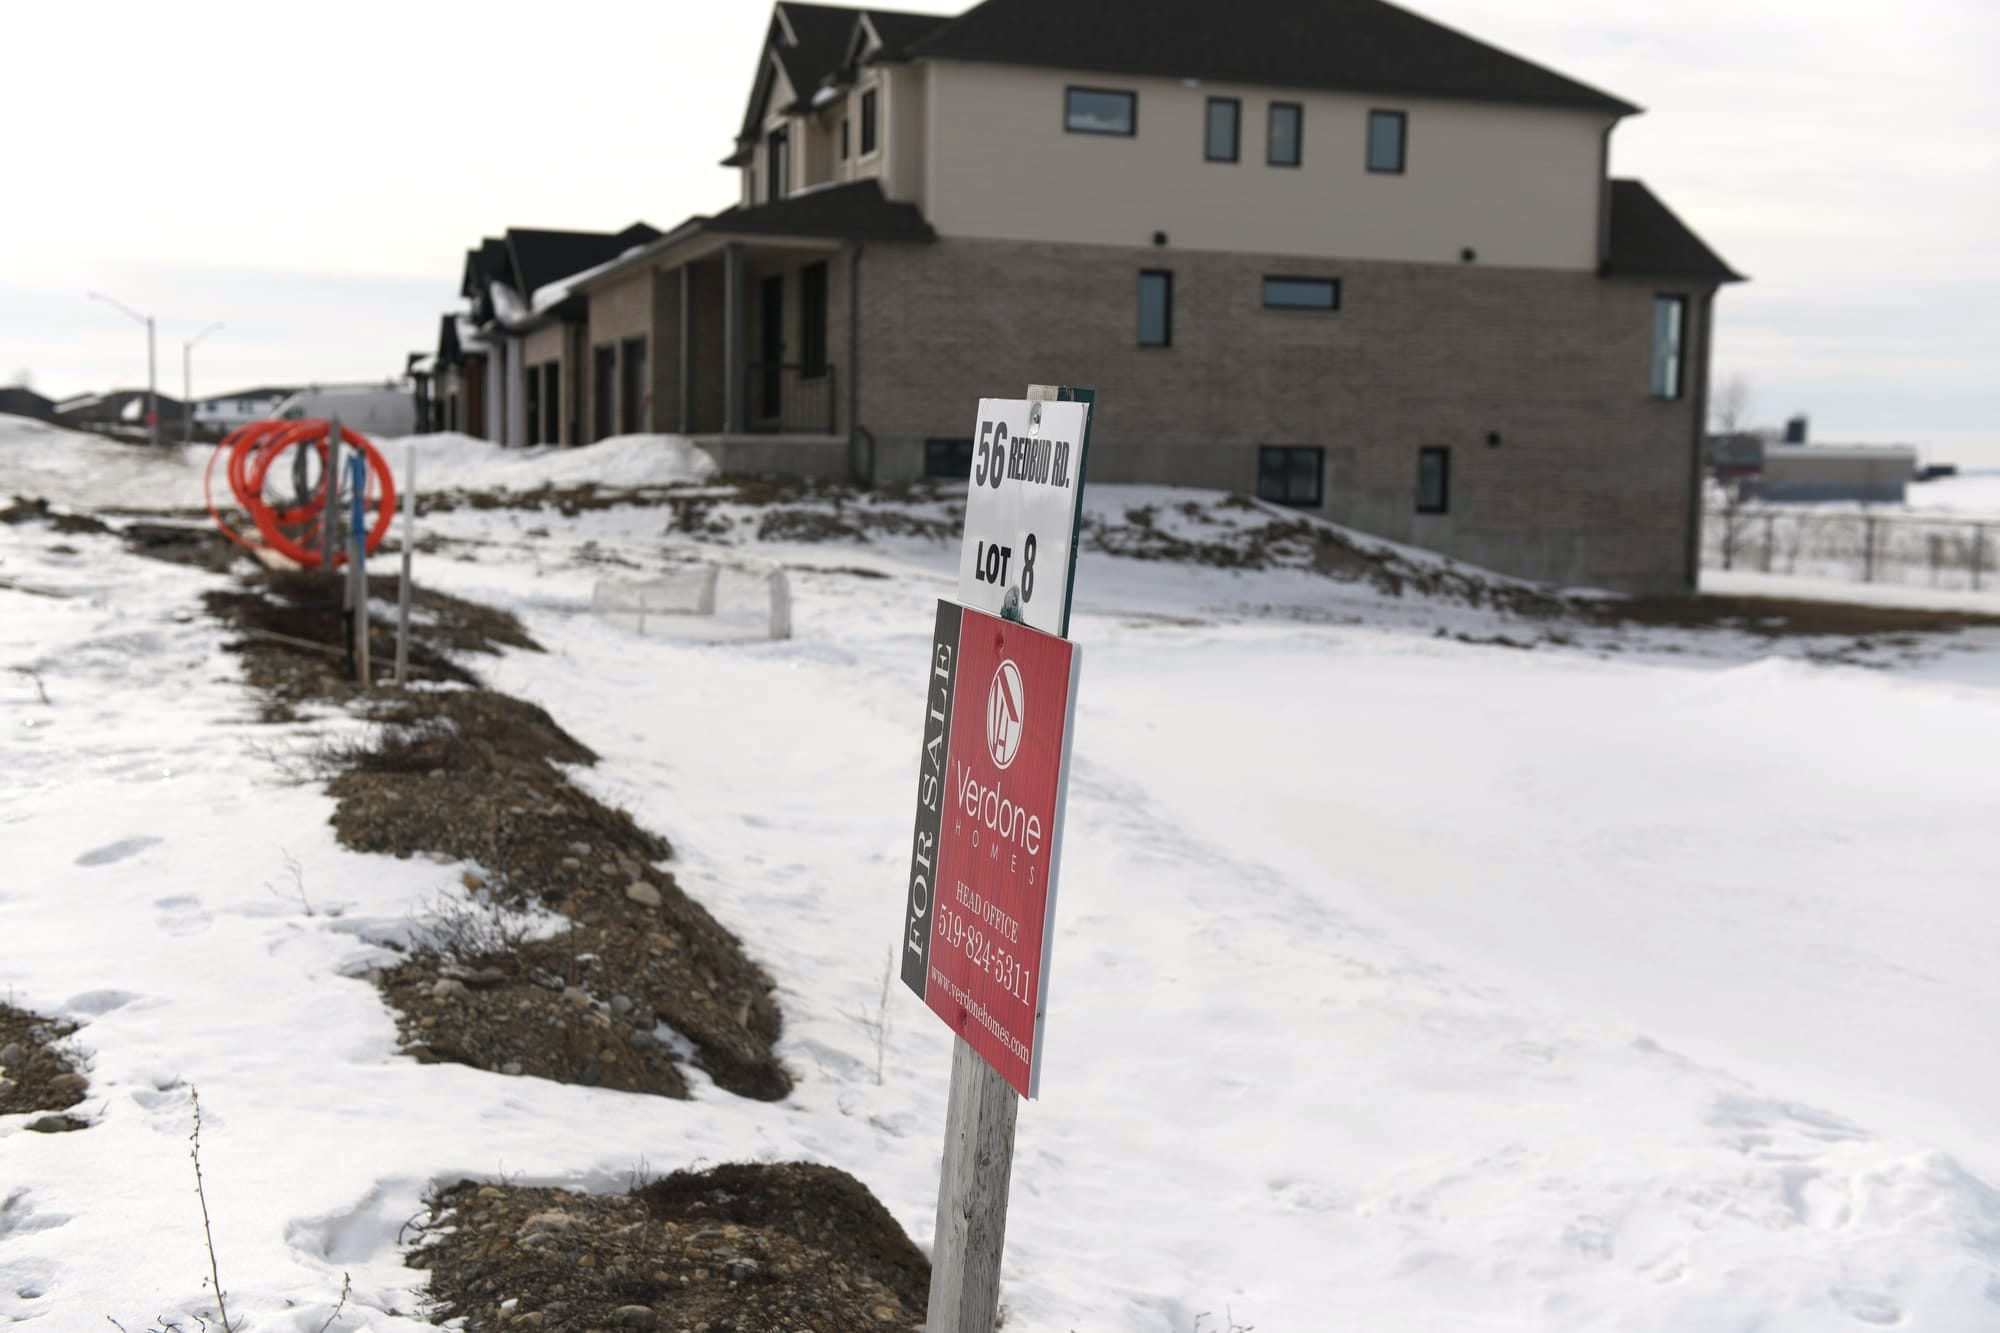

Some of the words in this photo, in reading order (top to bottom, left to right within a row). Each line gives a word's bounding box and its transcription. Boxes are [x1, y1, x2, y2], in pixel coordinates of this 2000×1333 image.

[976, 421, 1007, 489] 56
[1007, 436, 1052, 484] REDBUD
[1051, 441, 1070, 488] RD.
[975, 540, 1011, 587] LOT
[1021, 533, 1037, 603] 8
[908, 830, 933, 964] FOR
[923, 643, 952, 812] SALE
[956, 759, 1041, 855] Verdone
[938, 903, 1031, 1007] 519-824-5311
[956, 880, 981, 916] HEAD
[983, 901, 1019, 944] OFFICE
[931, 966, 1030, 1065] www.verdonehomes.com
